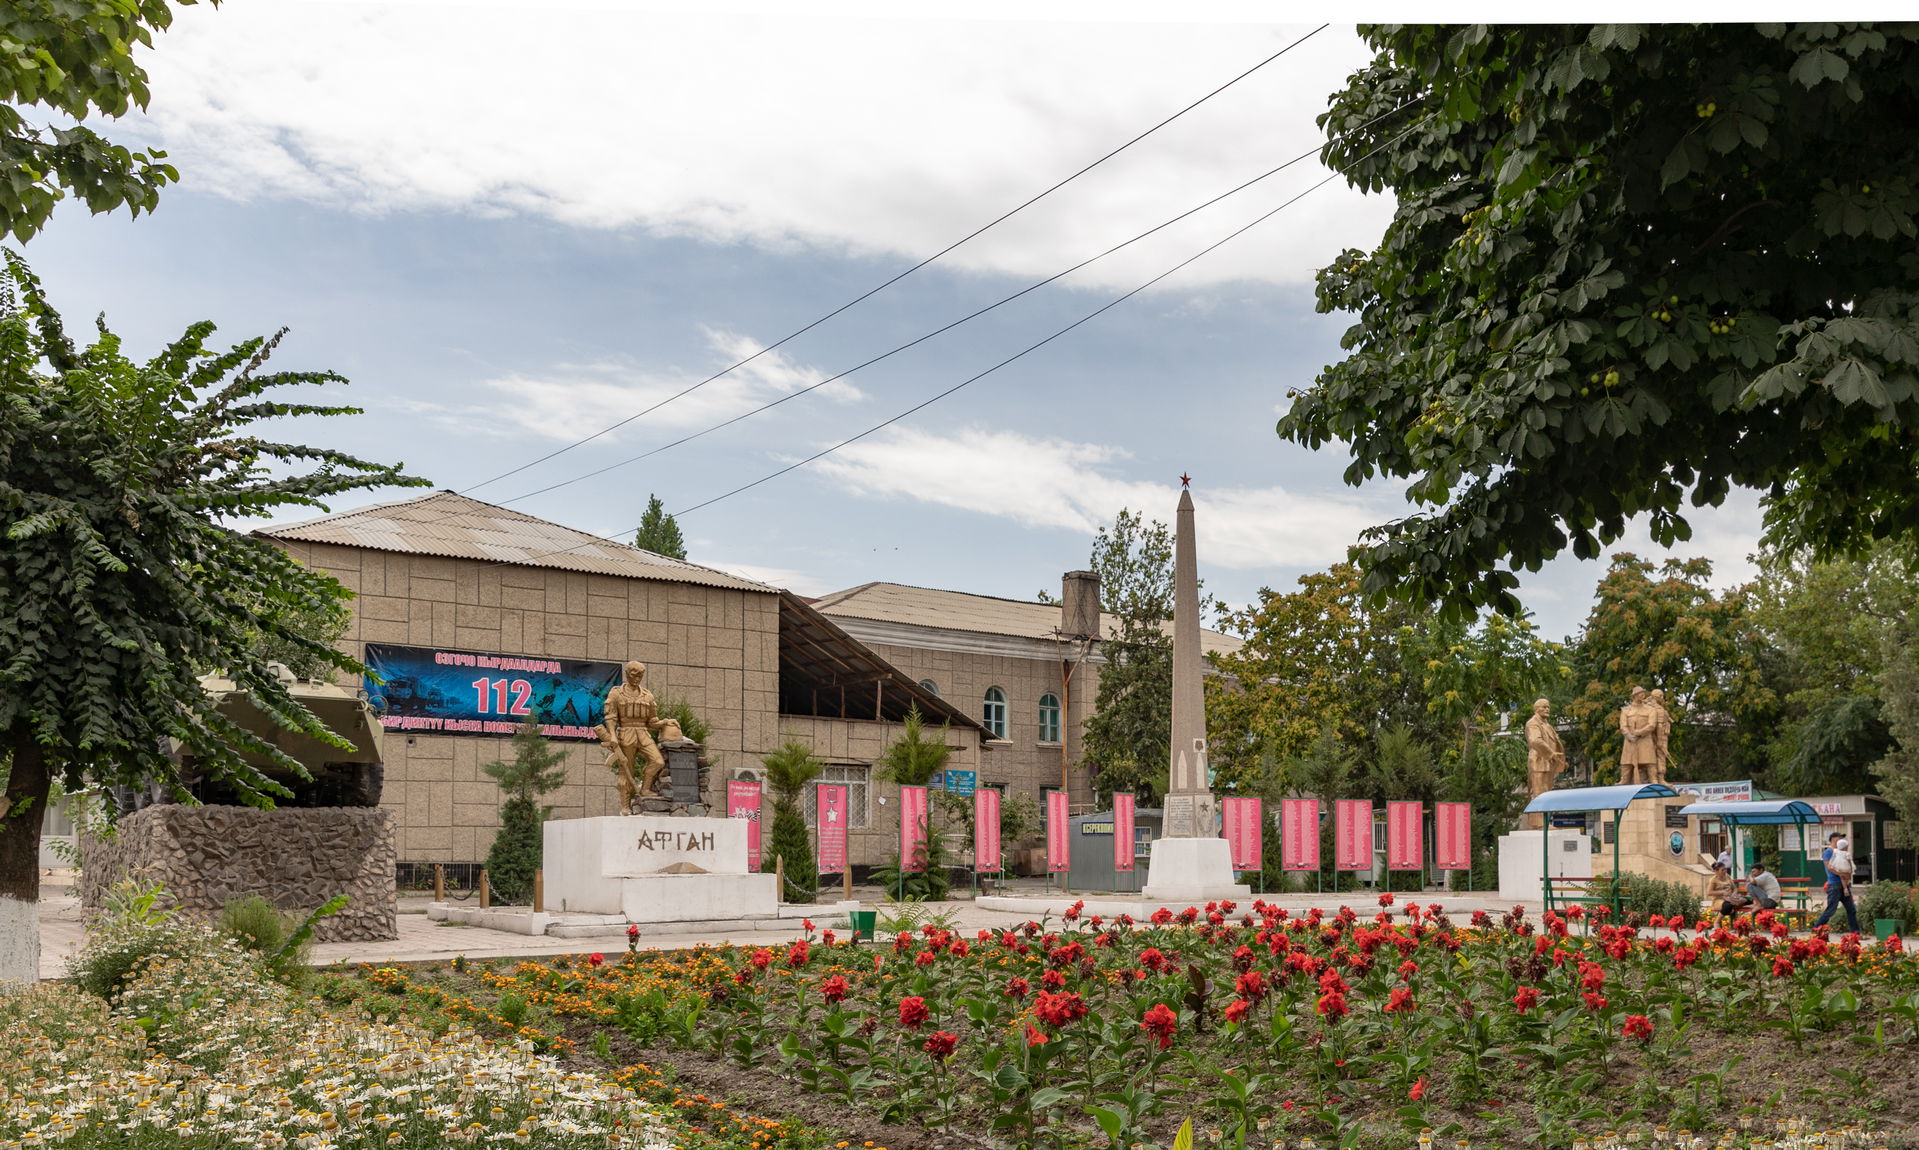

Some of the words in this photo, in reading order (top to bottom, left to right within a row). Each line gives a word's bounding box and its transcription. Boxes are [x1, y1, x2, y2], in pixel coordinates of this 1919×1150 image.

[472, 677, 532, 716] 112
[444, 719, 483, 732] КЫСКА
[638, 829, 714, 851] АФГАН
